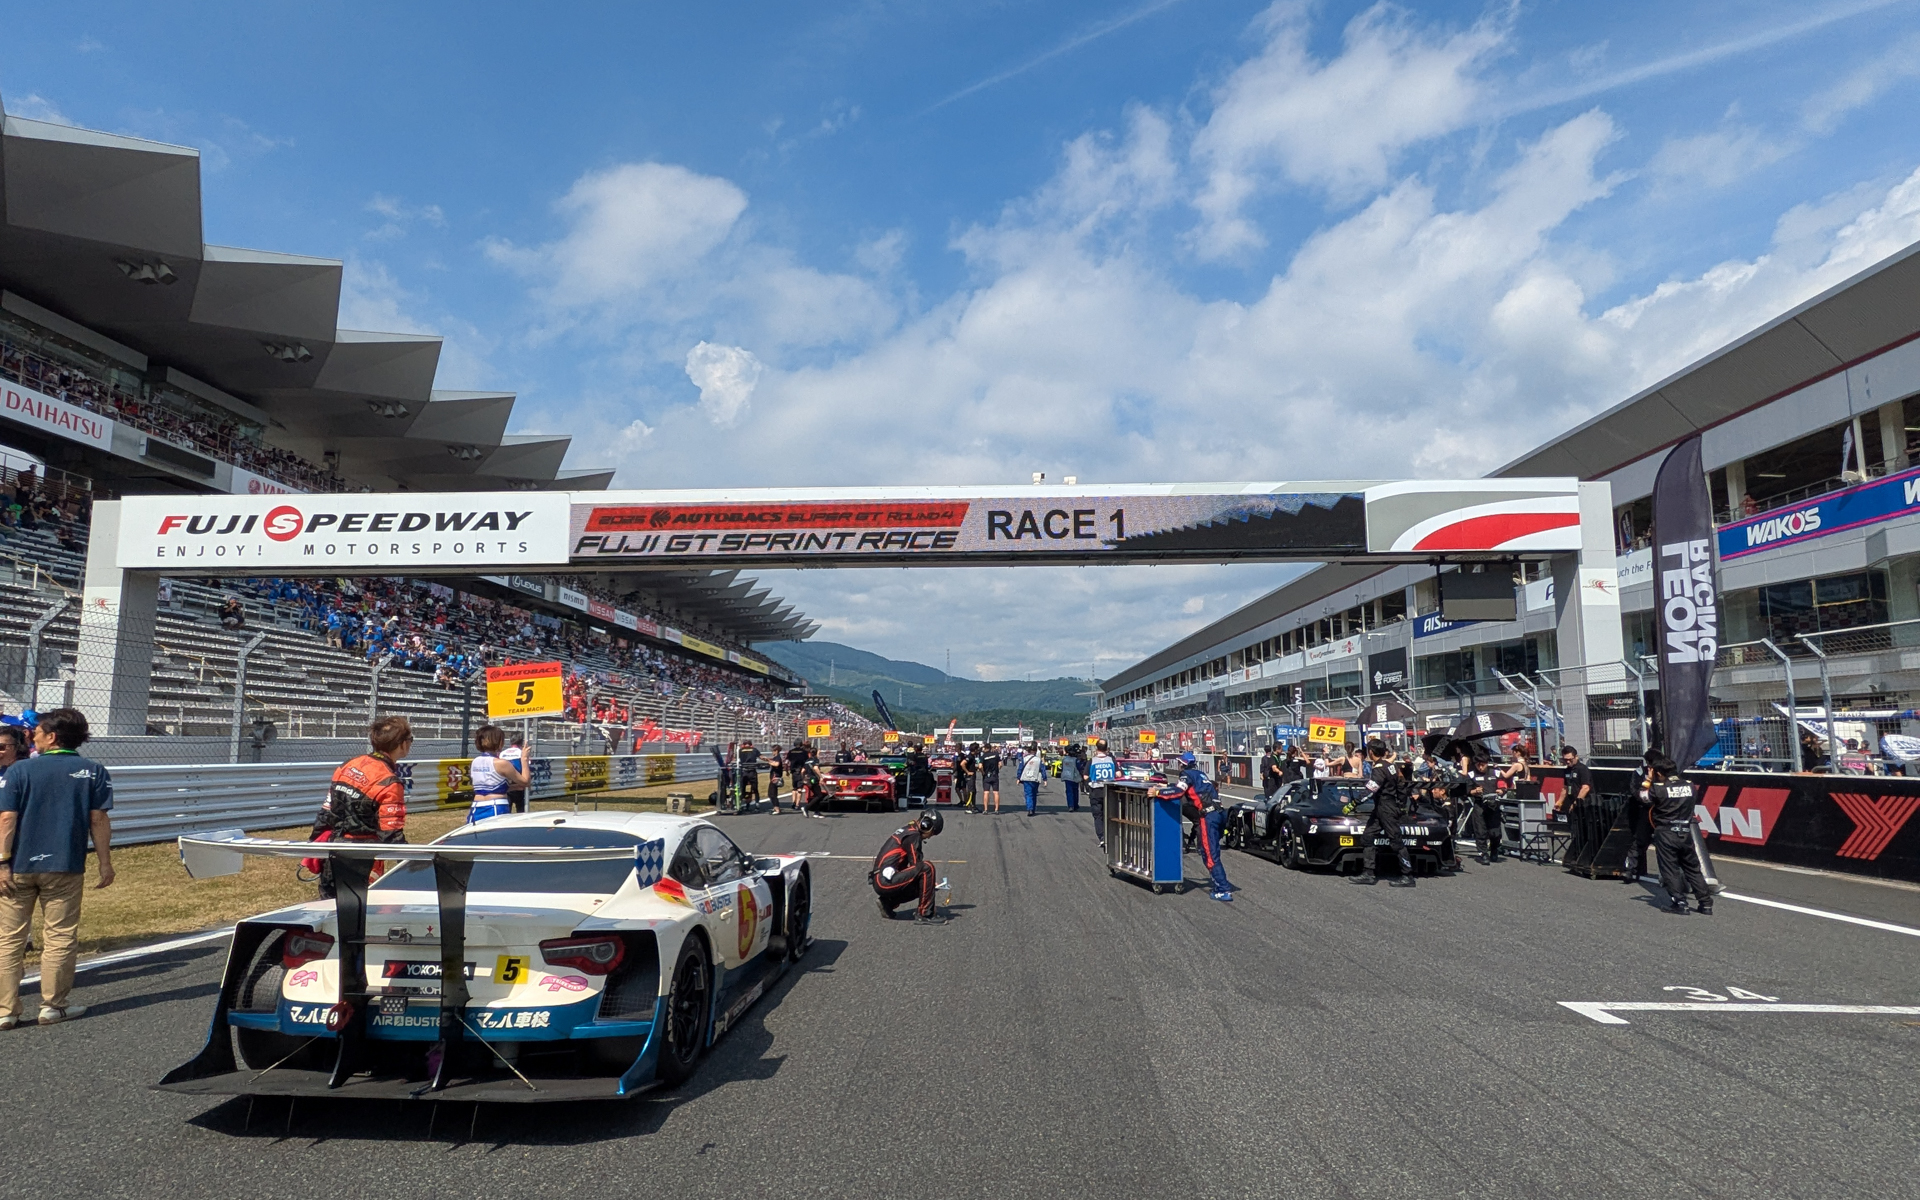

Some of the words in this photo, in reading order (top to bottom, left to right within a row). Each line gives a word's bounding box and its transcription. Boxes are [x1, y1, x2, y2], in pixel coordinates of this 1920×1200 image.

[6, 390, 103, 439] DAIHATSU
[157, 515, 259, 535] FUJI
[600, 515, 646, 525] 2025
[672, 512, 783, 524] AUTOBACS
[787, 511, 853, 522] SUPER
[855, 511, 883, 521] GT
[987, 509, 1097, 540] RACE
[1109, 508, 1125, 539] 1
[157, 545, 262, 557] ENJOY!
[303, 542, 527, 556] MOTORSPORTS
[574, 535, 660, 553] FUJI
[664, 534, 718, 552] GT
[717, 532, 856, 551] SPRINT
[856, 531, 960, 550] RACE
[1631, 563, 1644, 574] the
[520, 580, 543, 593] LEXUS
[589, 603, 615, 618] NISSAN
[615, 612, 637, 627] NISSAN
[637, 620, 657, 633] NISSAN
[501, 666, 559, 677] AUTOBACS
[515, 681, 535, 705] 5
[815, 725, 821, 733] 6
[1316, 726, 1337, 738] 65
[1095, 769, 1113, 779] 501
[1666, 785, 1692, 795] LEON
[741, 889, 754, 952] 5
[502, 958, 521, 981] 5
